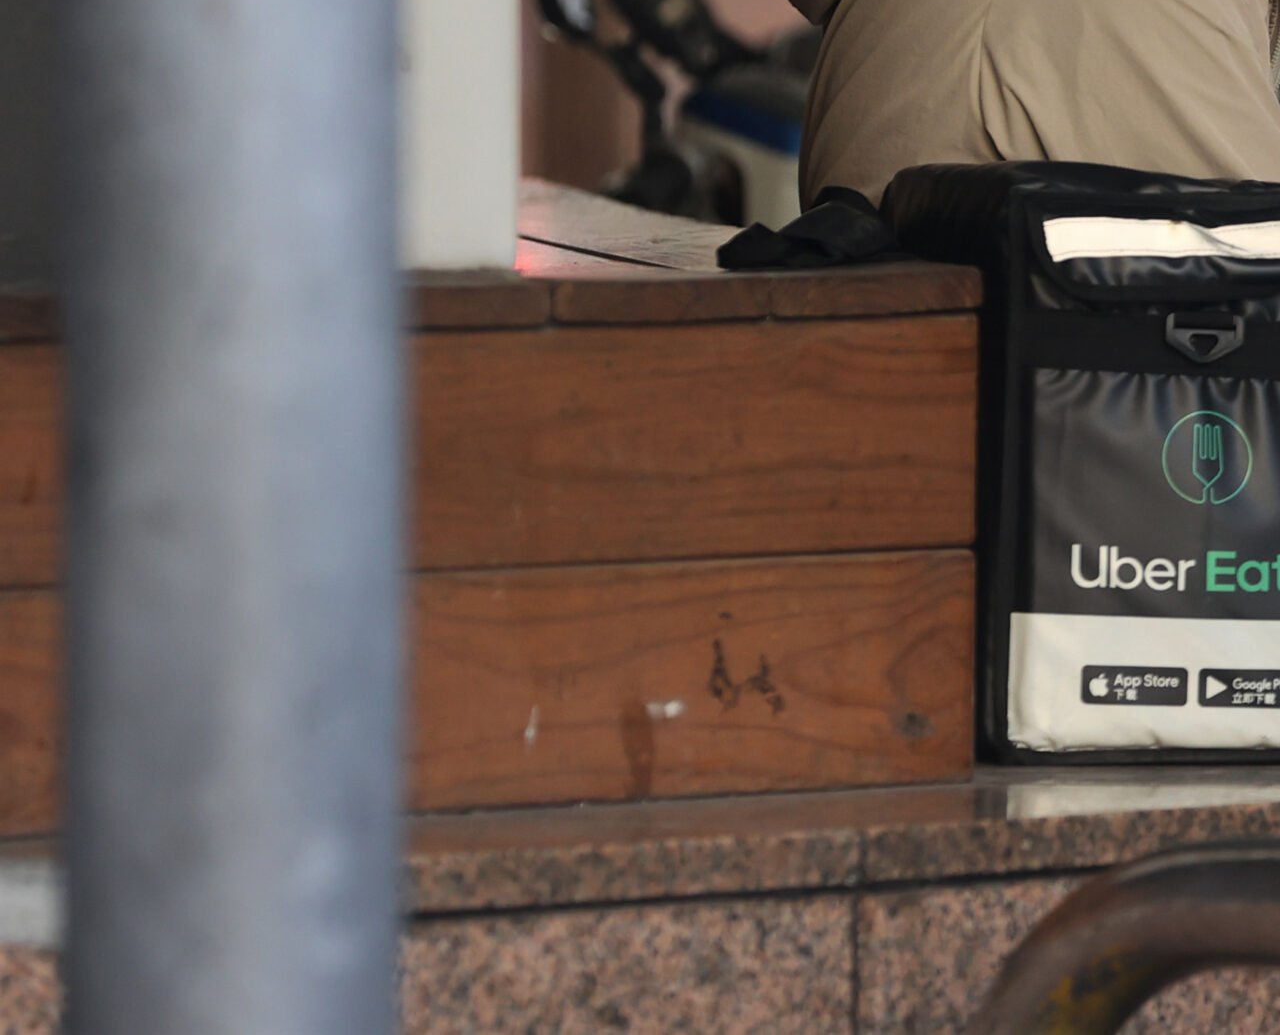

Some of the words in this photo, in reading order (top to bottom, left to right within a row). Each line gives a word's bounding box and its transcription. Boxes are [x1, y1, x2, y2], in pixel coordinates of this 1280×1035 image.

[1071, 543, 1196, 592] Uber
[1113, 673, 1142, 690] App
[1143, 673, 1179, 689] Store
[1231, 677, 1272, 692] Google
